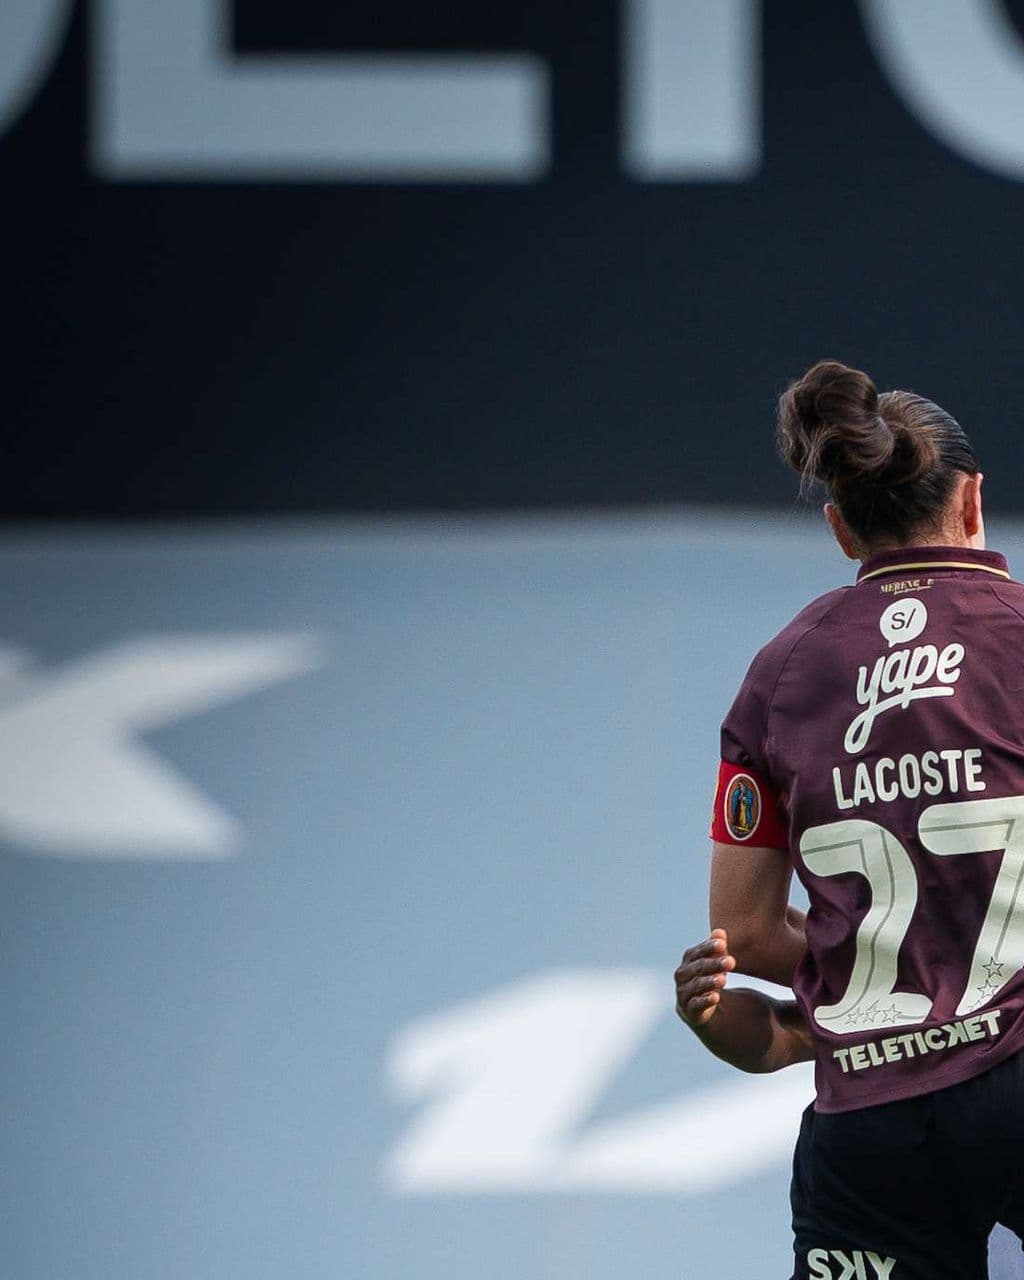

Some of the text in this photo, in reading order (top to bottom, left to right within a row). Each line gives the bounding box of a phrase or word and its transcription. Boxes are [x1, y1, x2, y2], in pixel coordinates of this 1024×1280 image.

[843, 642, 965, 755] yape
[832, 748, 987, 811] LACOSTE
[831, 1009, 1002, 1075] TELETICKET
